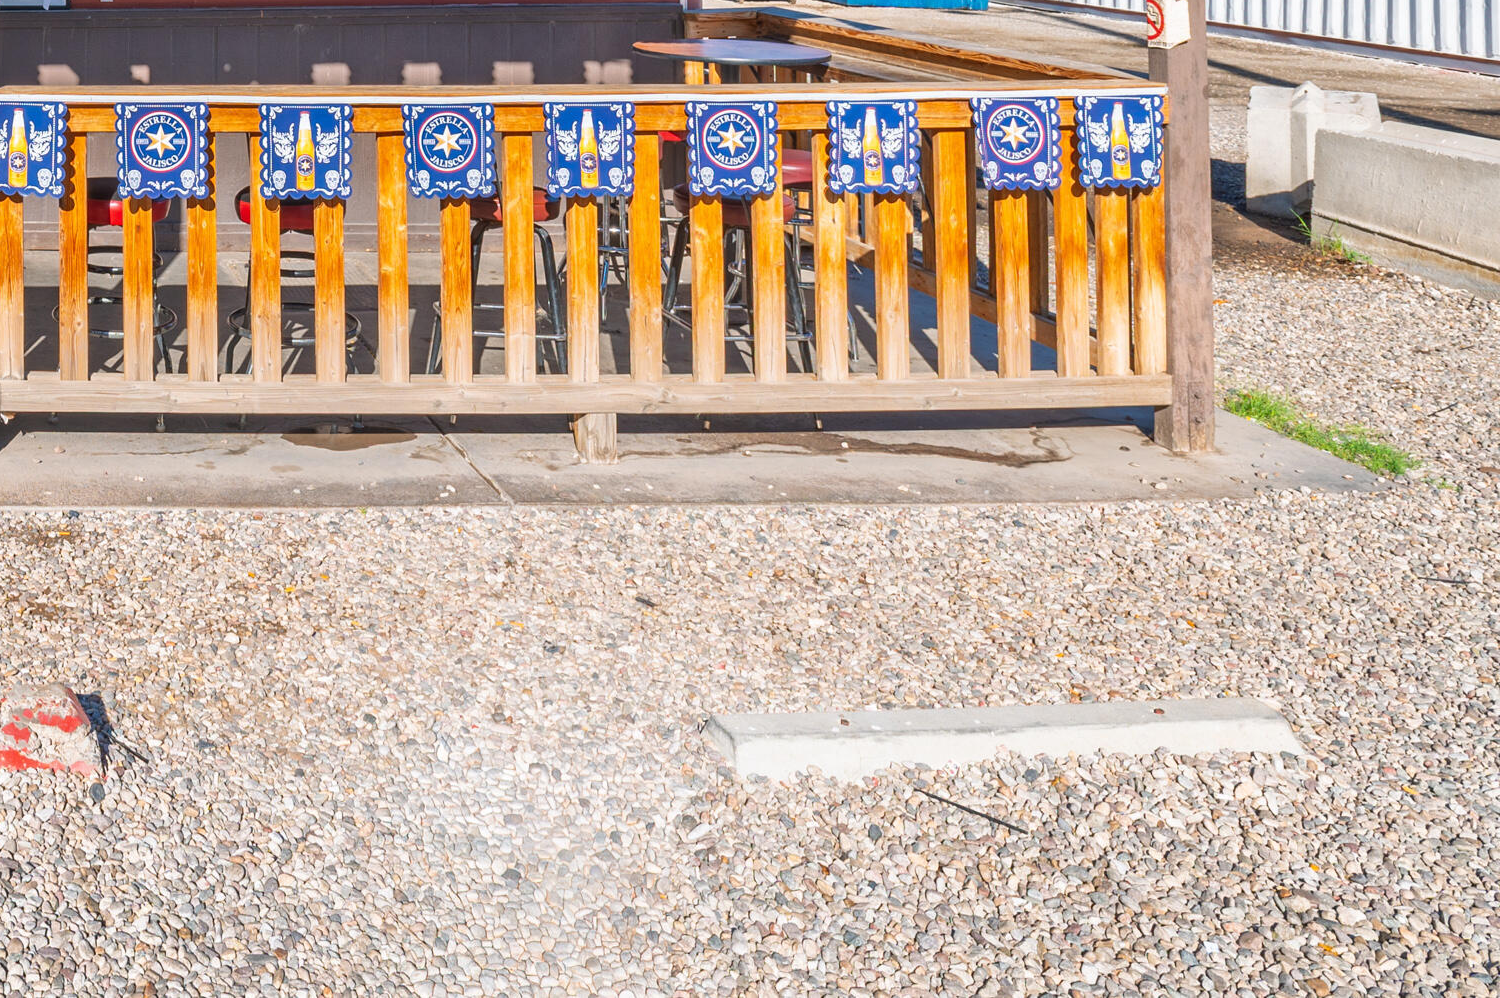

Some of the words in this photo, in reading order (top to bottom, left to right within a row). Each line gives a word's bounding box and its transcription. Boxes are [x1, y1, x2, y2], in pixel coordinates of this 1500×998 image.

[139, 115, 183, 134] ESTRELLA
[425, 115, 469, 135] ESTRELLA
[709, 114, 753, 133] ESTRELLA
[992, 109, 1035, 128] ESTRELLA
[143, 154, 180, 168] JALISCO
[430, 155, 465, 168] JALISCO
[714, 152, 750, 165] JALISCO
[997, 147, 1031, 160] JALISCO
